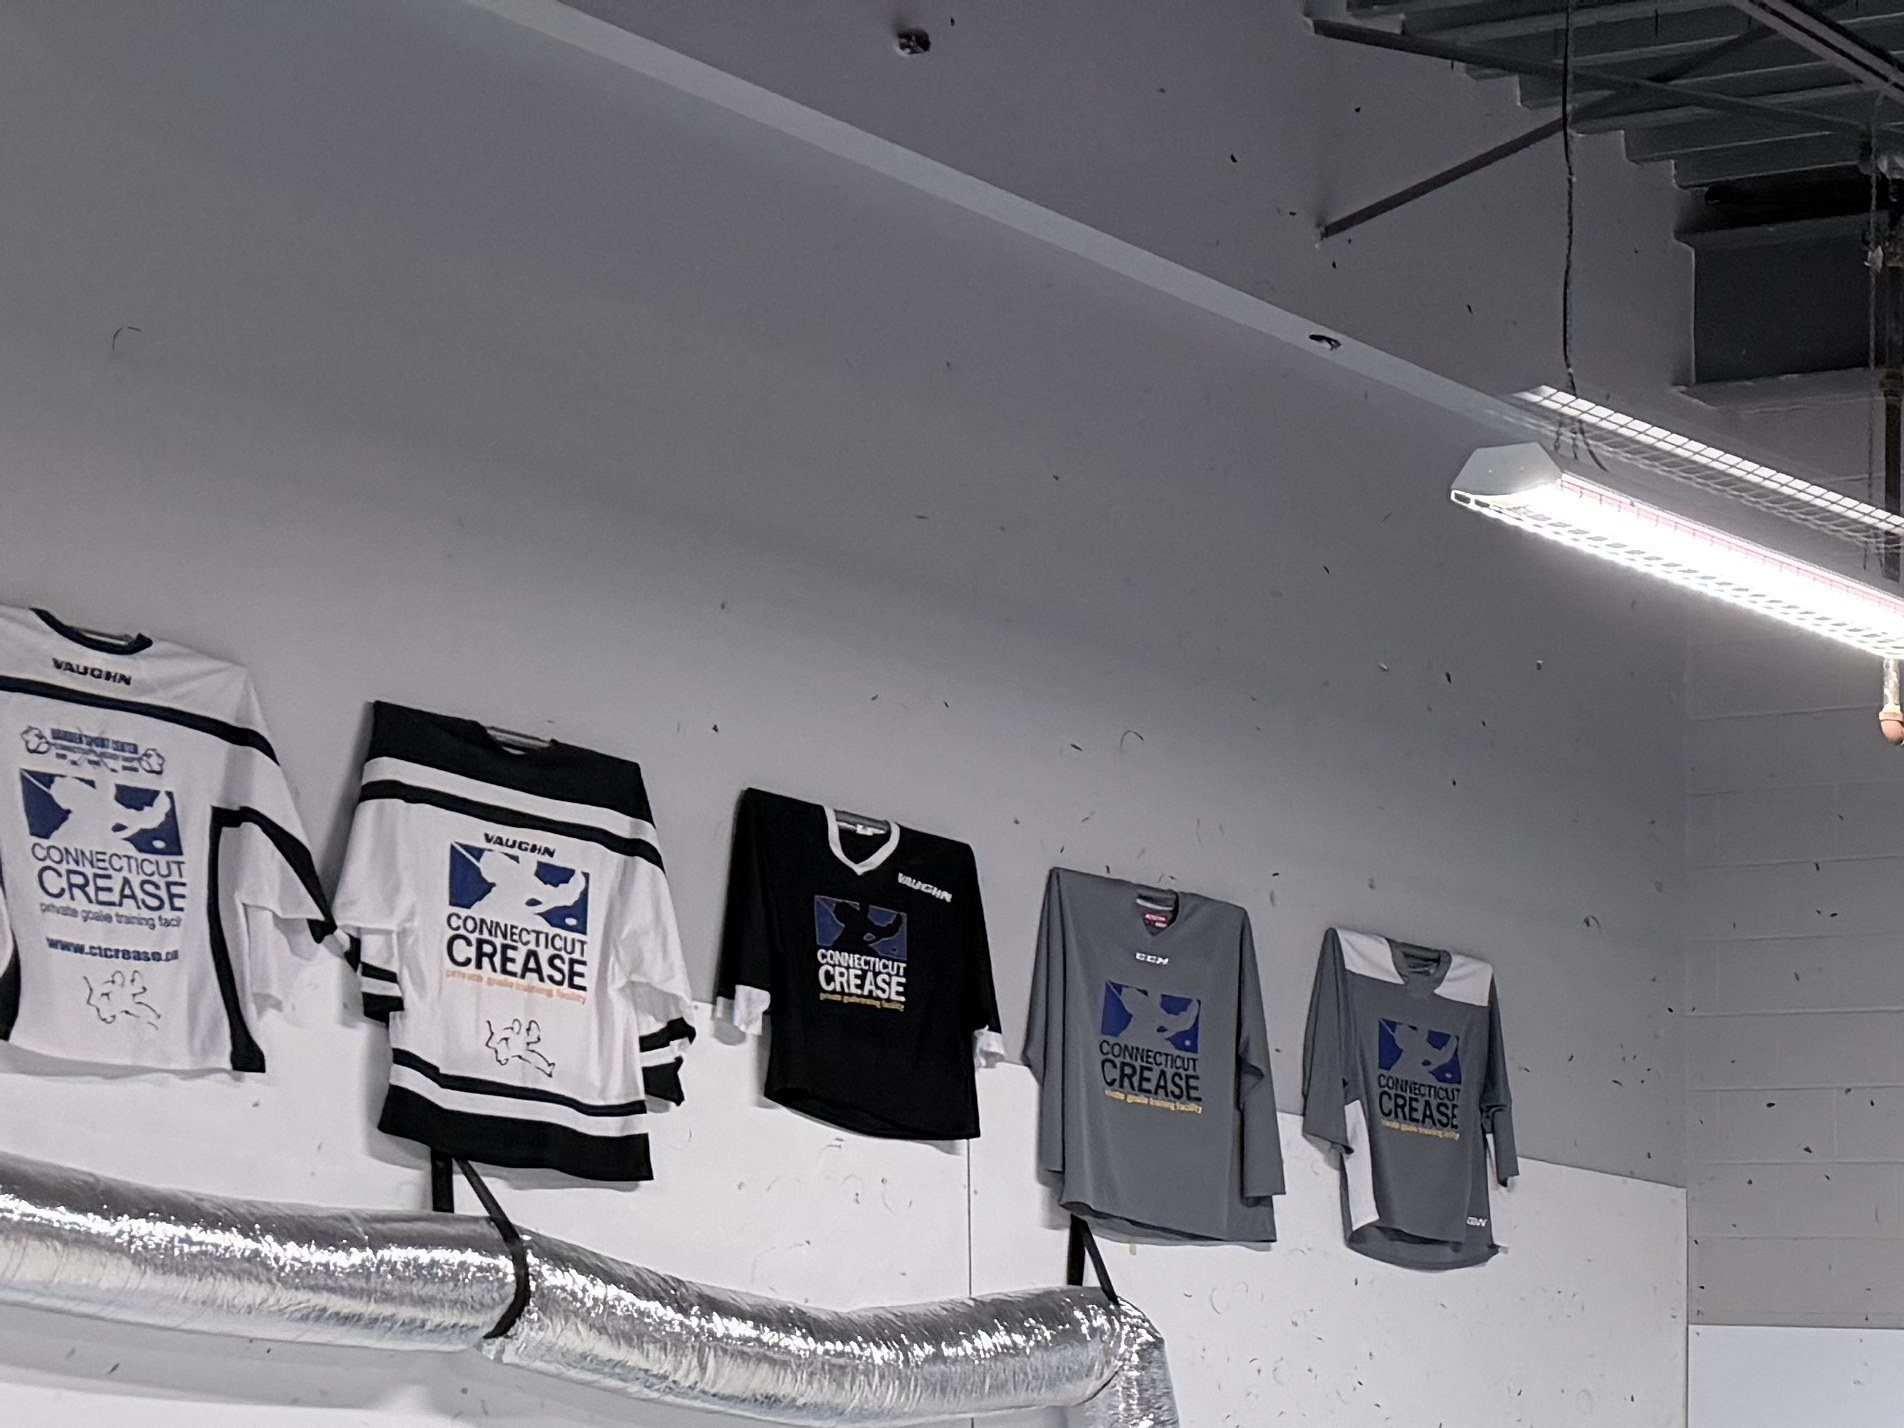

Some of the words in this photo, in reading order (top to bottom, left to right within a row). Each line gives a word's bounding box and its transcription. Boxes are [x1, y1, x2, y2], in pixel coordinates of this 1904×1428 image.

[52, 657, 132, 686] VAUGHN
[31, 842, 185, 878] CONNECTICUT
[483, 832, 556, 858] VAUGHN
[37, 866, 187, 912] CREASE
[897, 872, 953, 903] VAUGHN
[447, 912, 588, 957] CONNECTICUT
[446, 933, 588, 992] CREASE
[817, 949, 907, 976] CONNECTICUT
[1135, 952, 1169, 965] CCM
[818, 965, 907, 1012] CREASE
[1100, 1040, 1198, 1072] CONNECTICUT
[1101, 1058, 1203, 1102] CREASE
[1378, 1074, 1461, 1101] CONNECTICUT
[1378, 1091, 1459, 1129] CREASE
